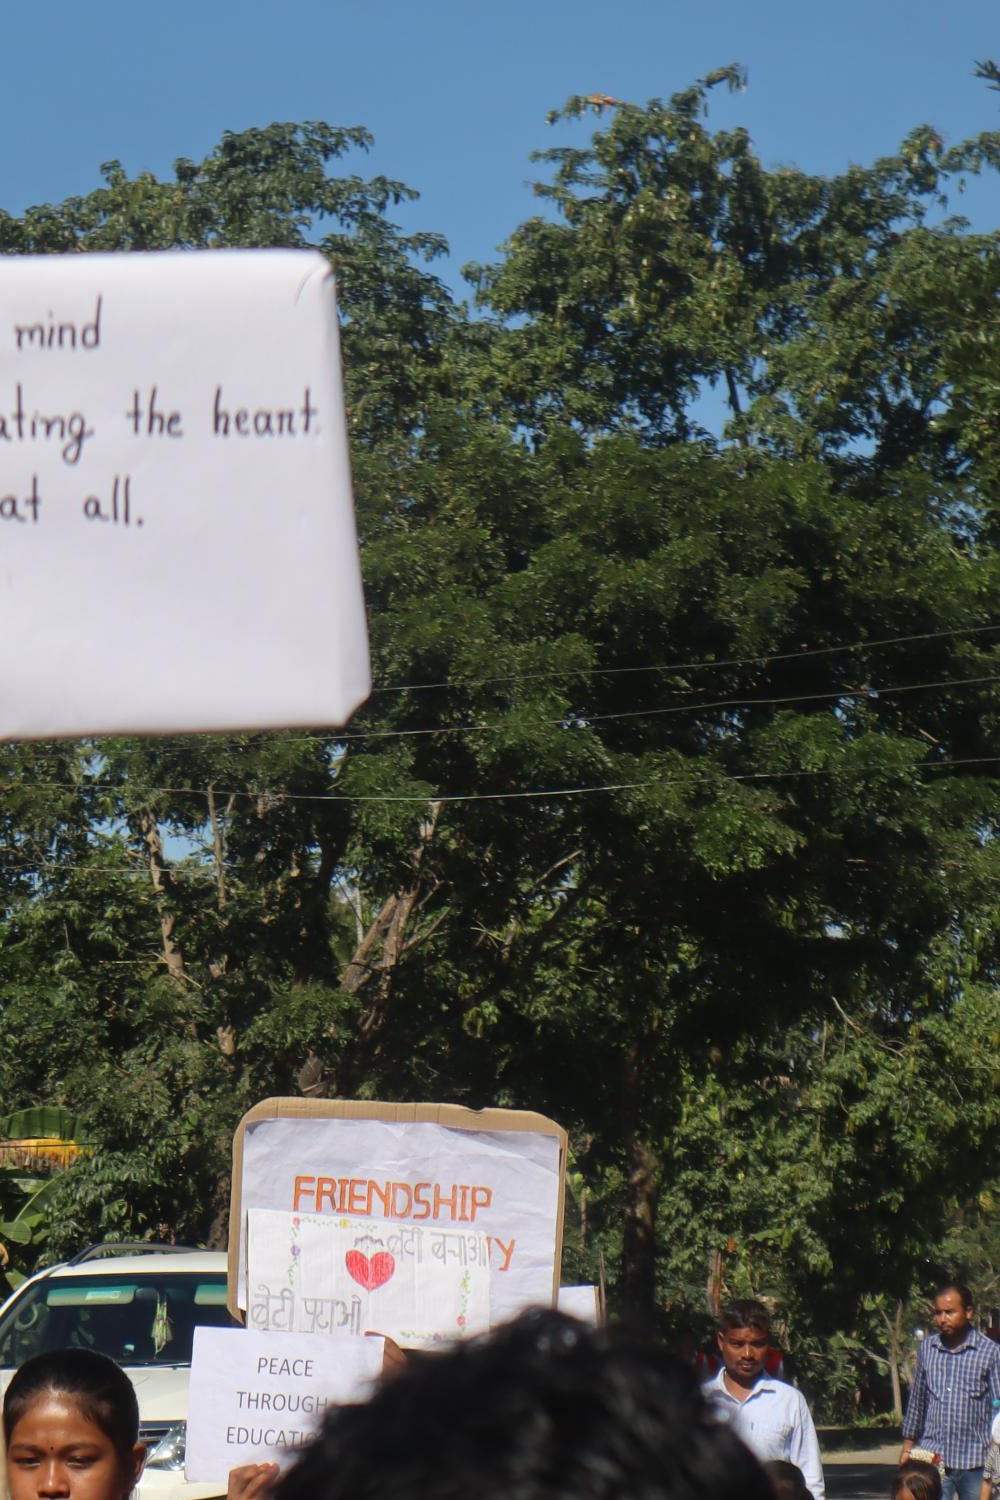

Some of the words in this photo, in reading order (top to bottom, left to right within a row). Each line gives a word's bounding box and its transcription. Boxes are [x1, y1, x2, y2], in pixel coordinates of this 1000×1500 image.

[15, 292, 104, 351] mind
[126, 386, 184, 437] the
[212, 386, 318, 436] heart
[83, 475, 145, 528] all.
[292, 1175, 494, 1222] FRIENDSHIP
[257, 1357, 314, 1377] PEACE
[236, 1391, 328, 1415] THROUGH
